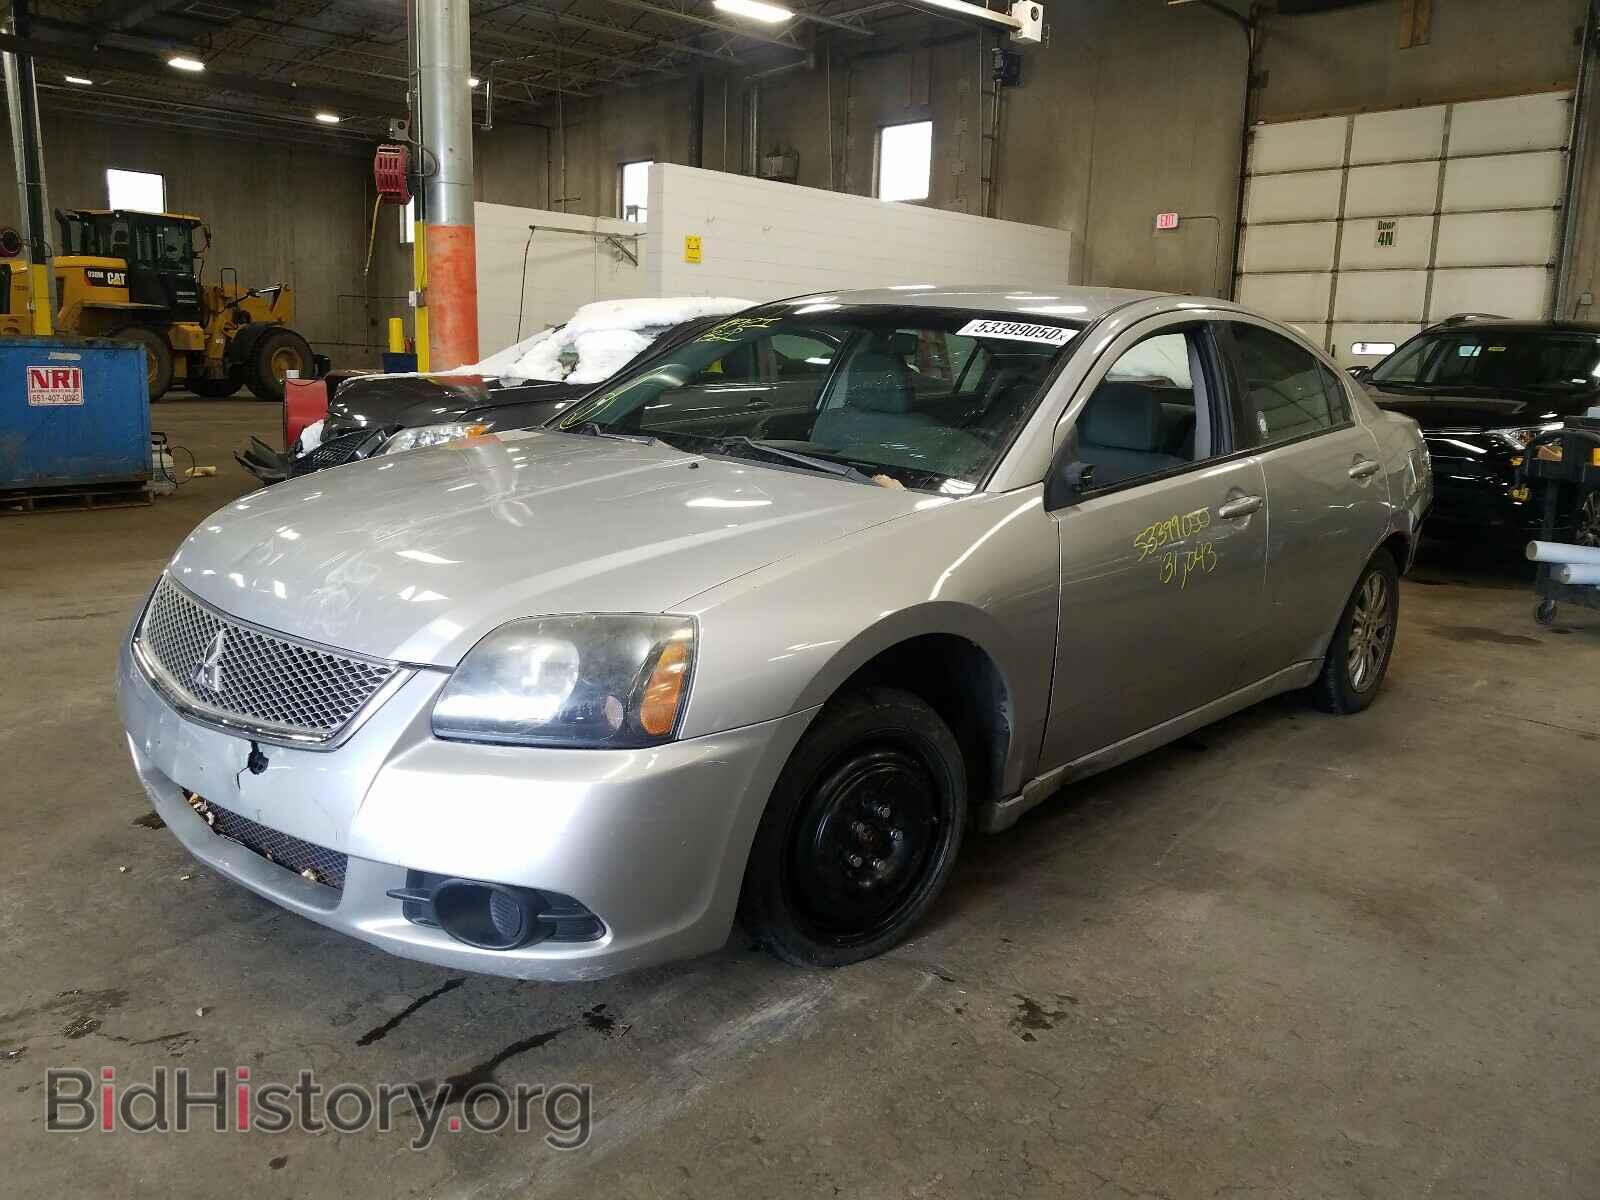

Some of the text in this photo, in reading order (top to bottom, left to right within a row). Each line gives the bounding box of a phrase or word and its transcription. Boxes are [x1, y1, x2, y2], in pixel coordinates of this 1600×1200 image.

[1160, 214, 1175, 226] EXIT
[1378, 220, 1396, 230] Door
[1378, 232, 1394, 246] 4N
[107, 272, 126, 285] CAT
[31, 370, 80, 388] NRI
